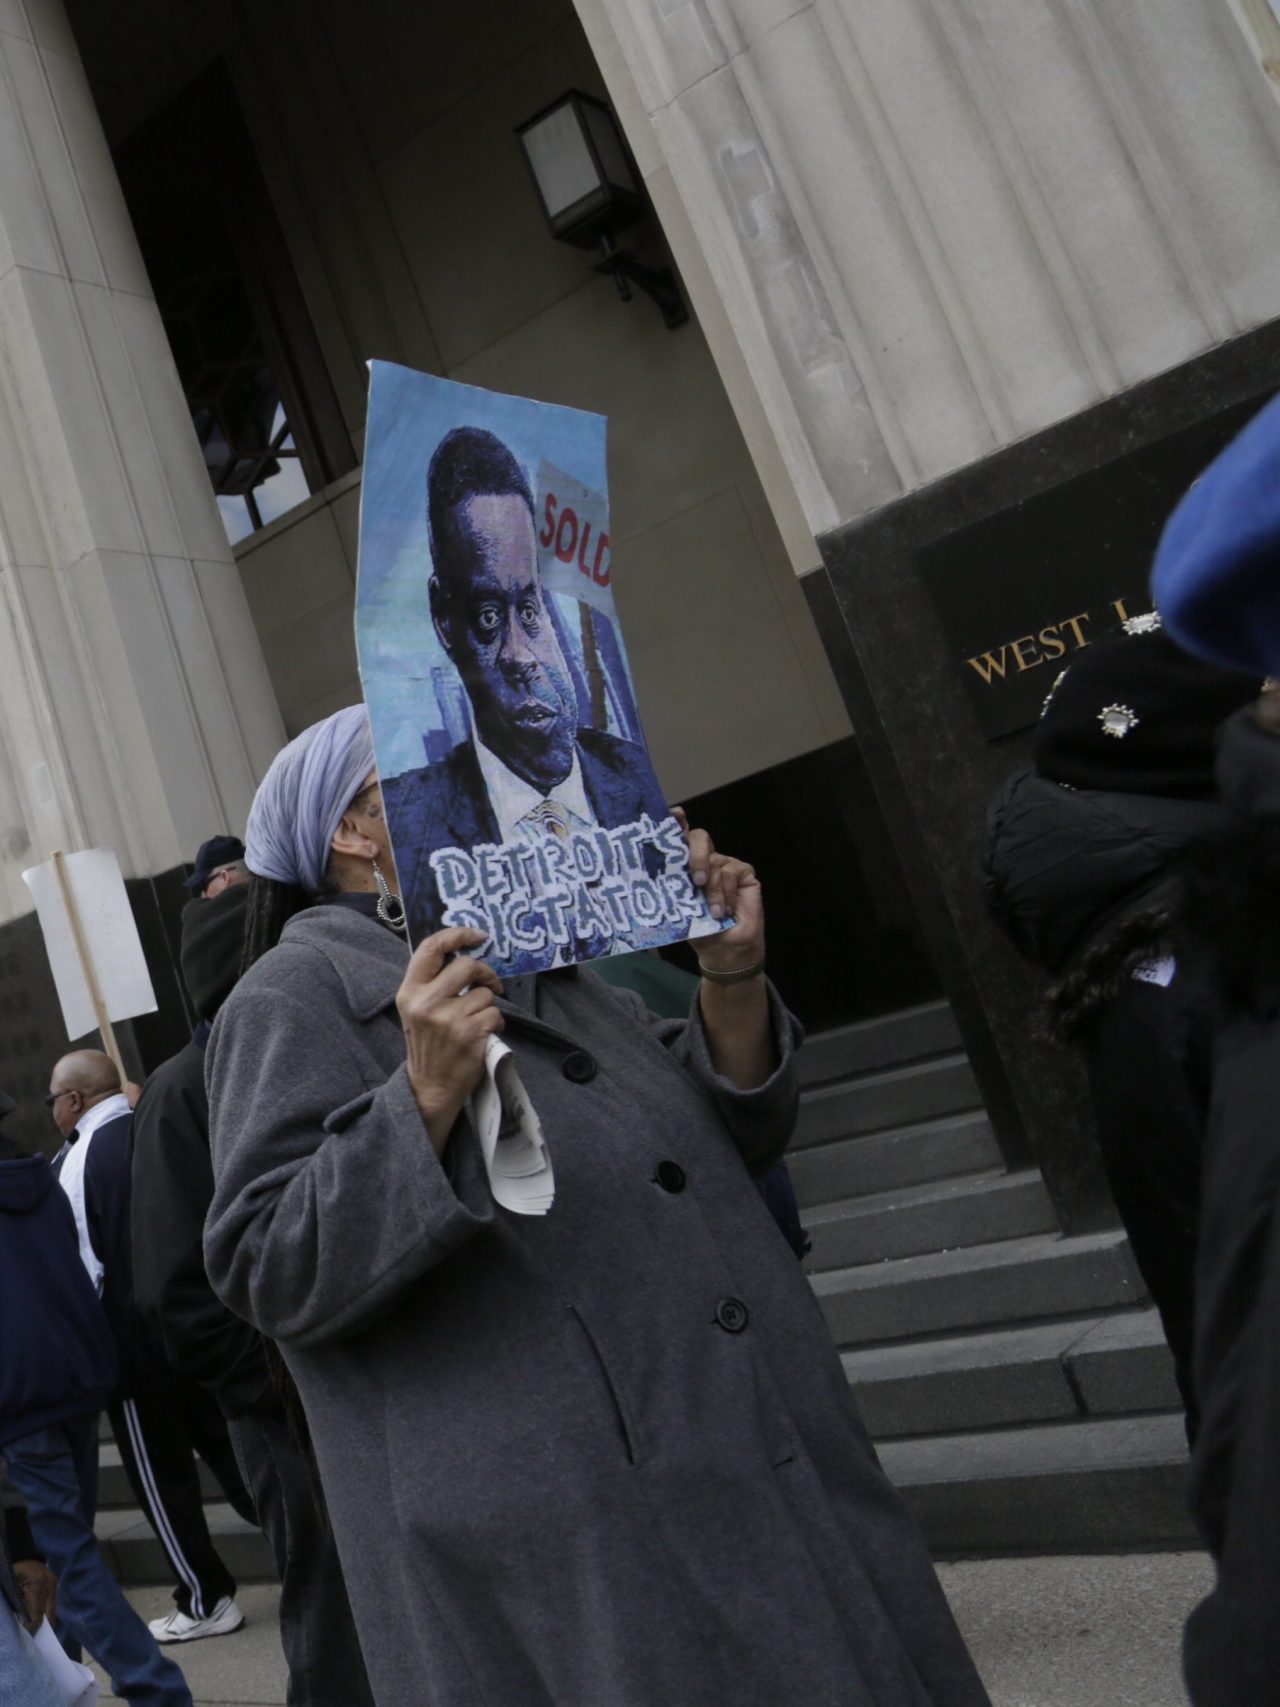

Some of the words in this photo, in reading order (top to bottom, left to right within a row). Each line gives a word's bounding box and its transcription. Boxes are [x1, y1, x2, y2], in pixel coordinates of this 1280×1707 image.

[539, 493, 612, 588] SOLD
[967, 612, 1091, 685] WEST
[429, 813, 691, 904] DETROIT'S
[442, 871, 705, 960] DICTATOR
